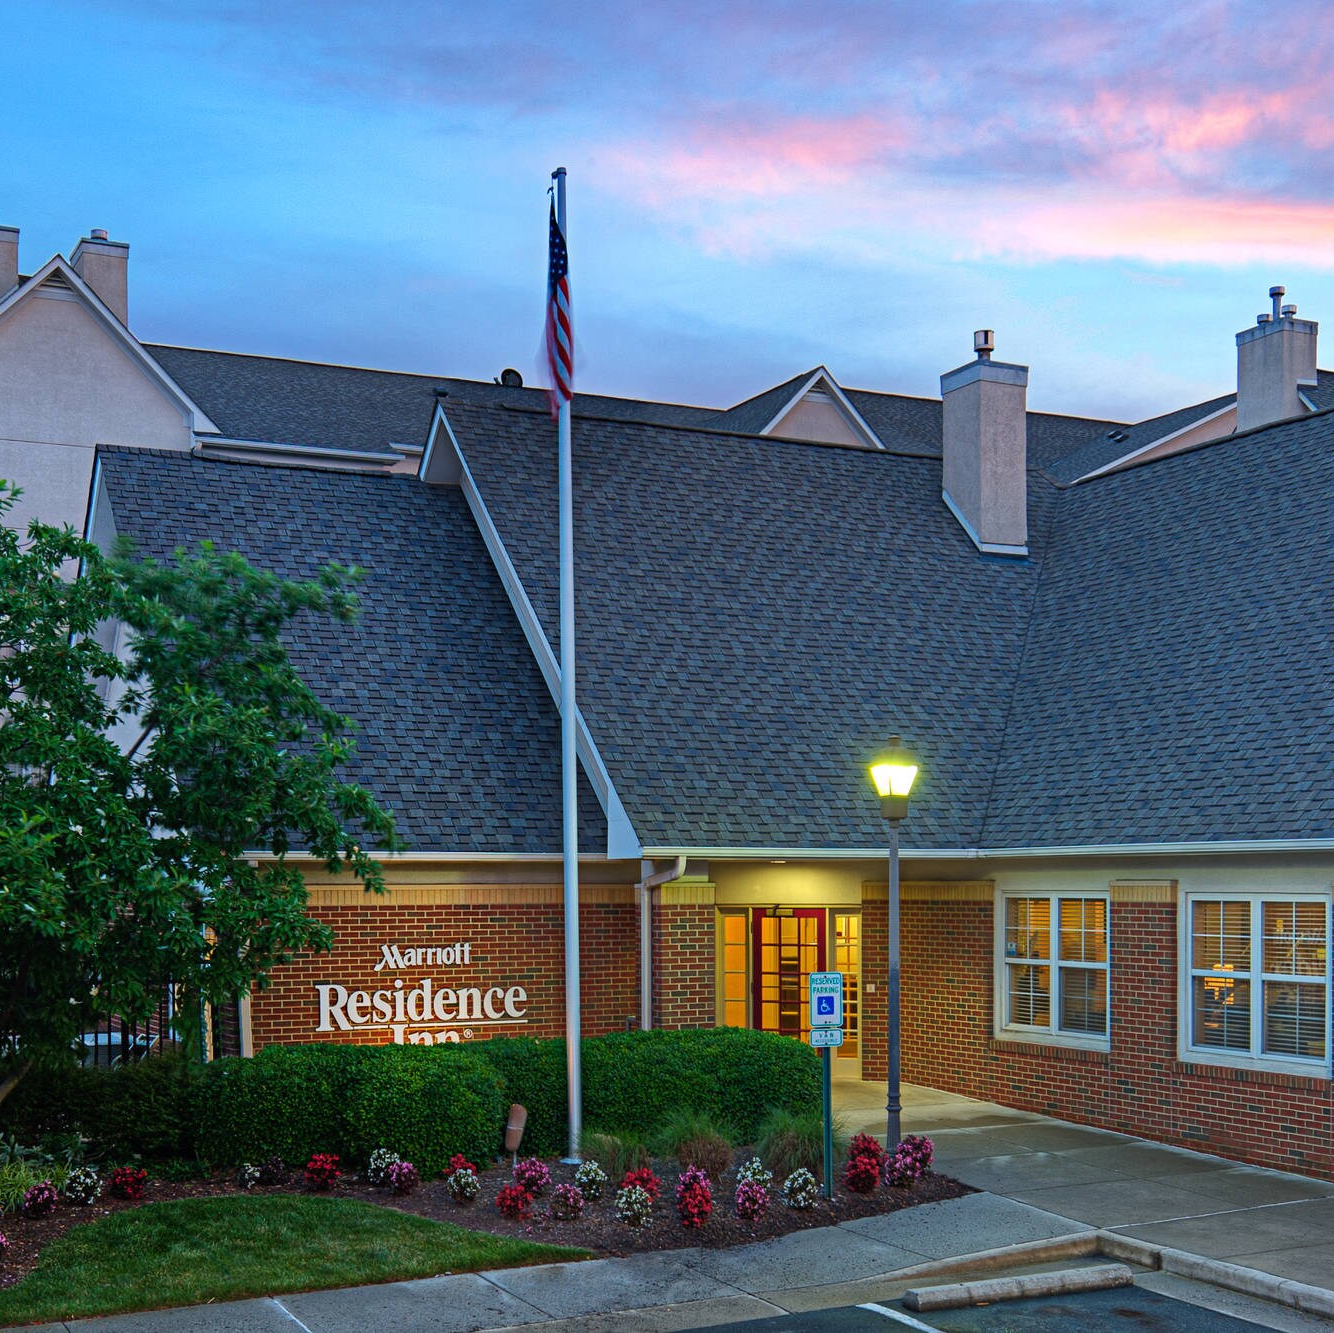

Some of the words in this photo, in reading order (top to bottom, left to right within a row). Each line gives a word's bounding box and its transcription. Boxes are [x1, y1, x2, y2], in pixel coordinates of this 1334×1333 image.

[373, 943, 471, 971] Marriott
[812, 977, 839, 985] RESERVED
[813, 986, 839, 994] PARKING
[315, 979, 527, 1031] Residence
